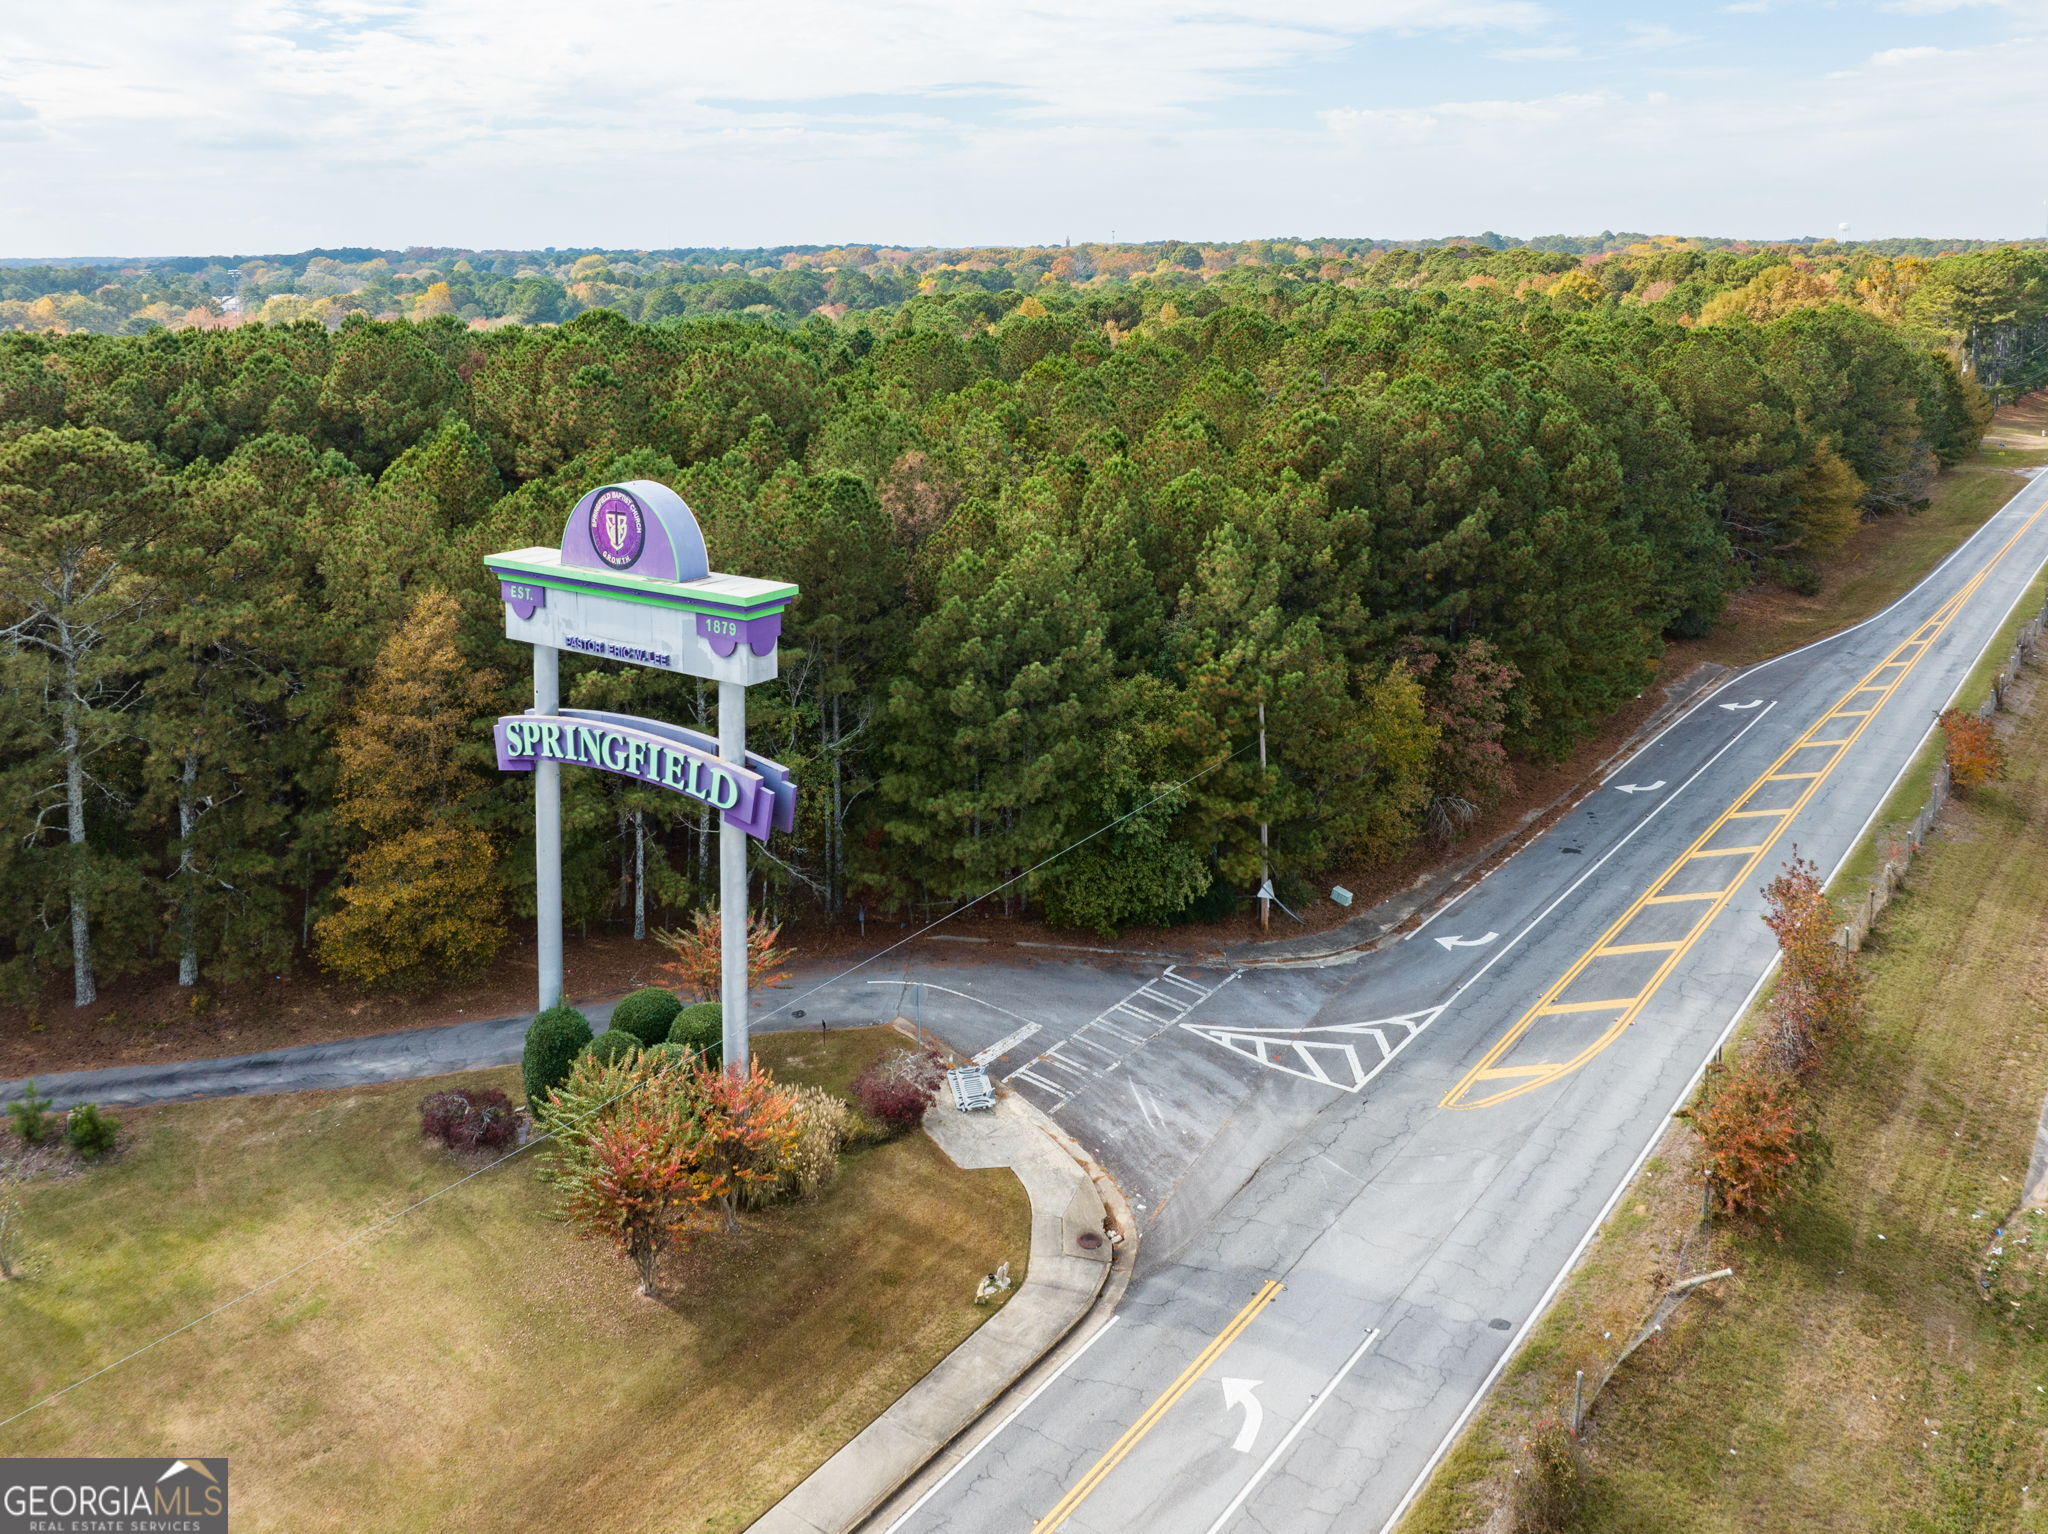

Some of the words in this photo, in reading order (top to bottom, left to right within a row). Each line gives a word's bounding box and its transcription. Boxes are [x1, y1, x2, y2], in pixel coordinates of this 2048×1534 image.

[591, 492, 611, 528] SPRINGFIELD
[612, 491, 631, 505] BAPTIST
[630, 503, 642, 533] CHURCH
[510, 585, 533, 601] EST.
[706, 619, 736, 636] 1879
[565, 636, 604, 653] PASTOR
[608, 643, 631, 658] ERIC
[648, 651, 670, 666] LEE
[506, 722, 738, 810] SPRINGFIELD
